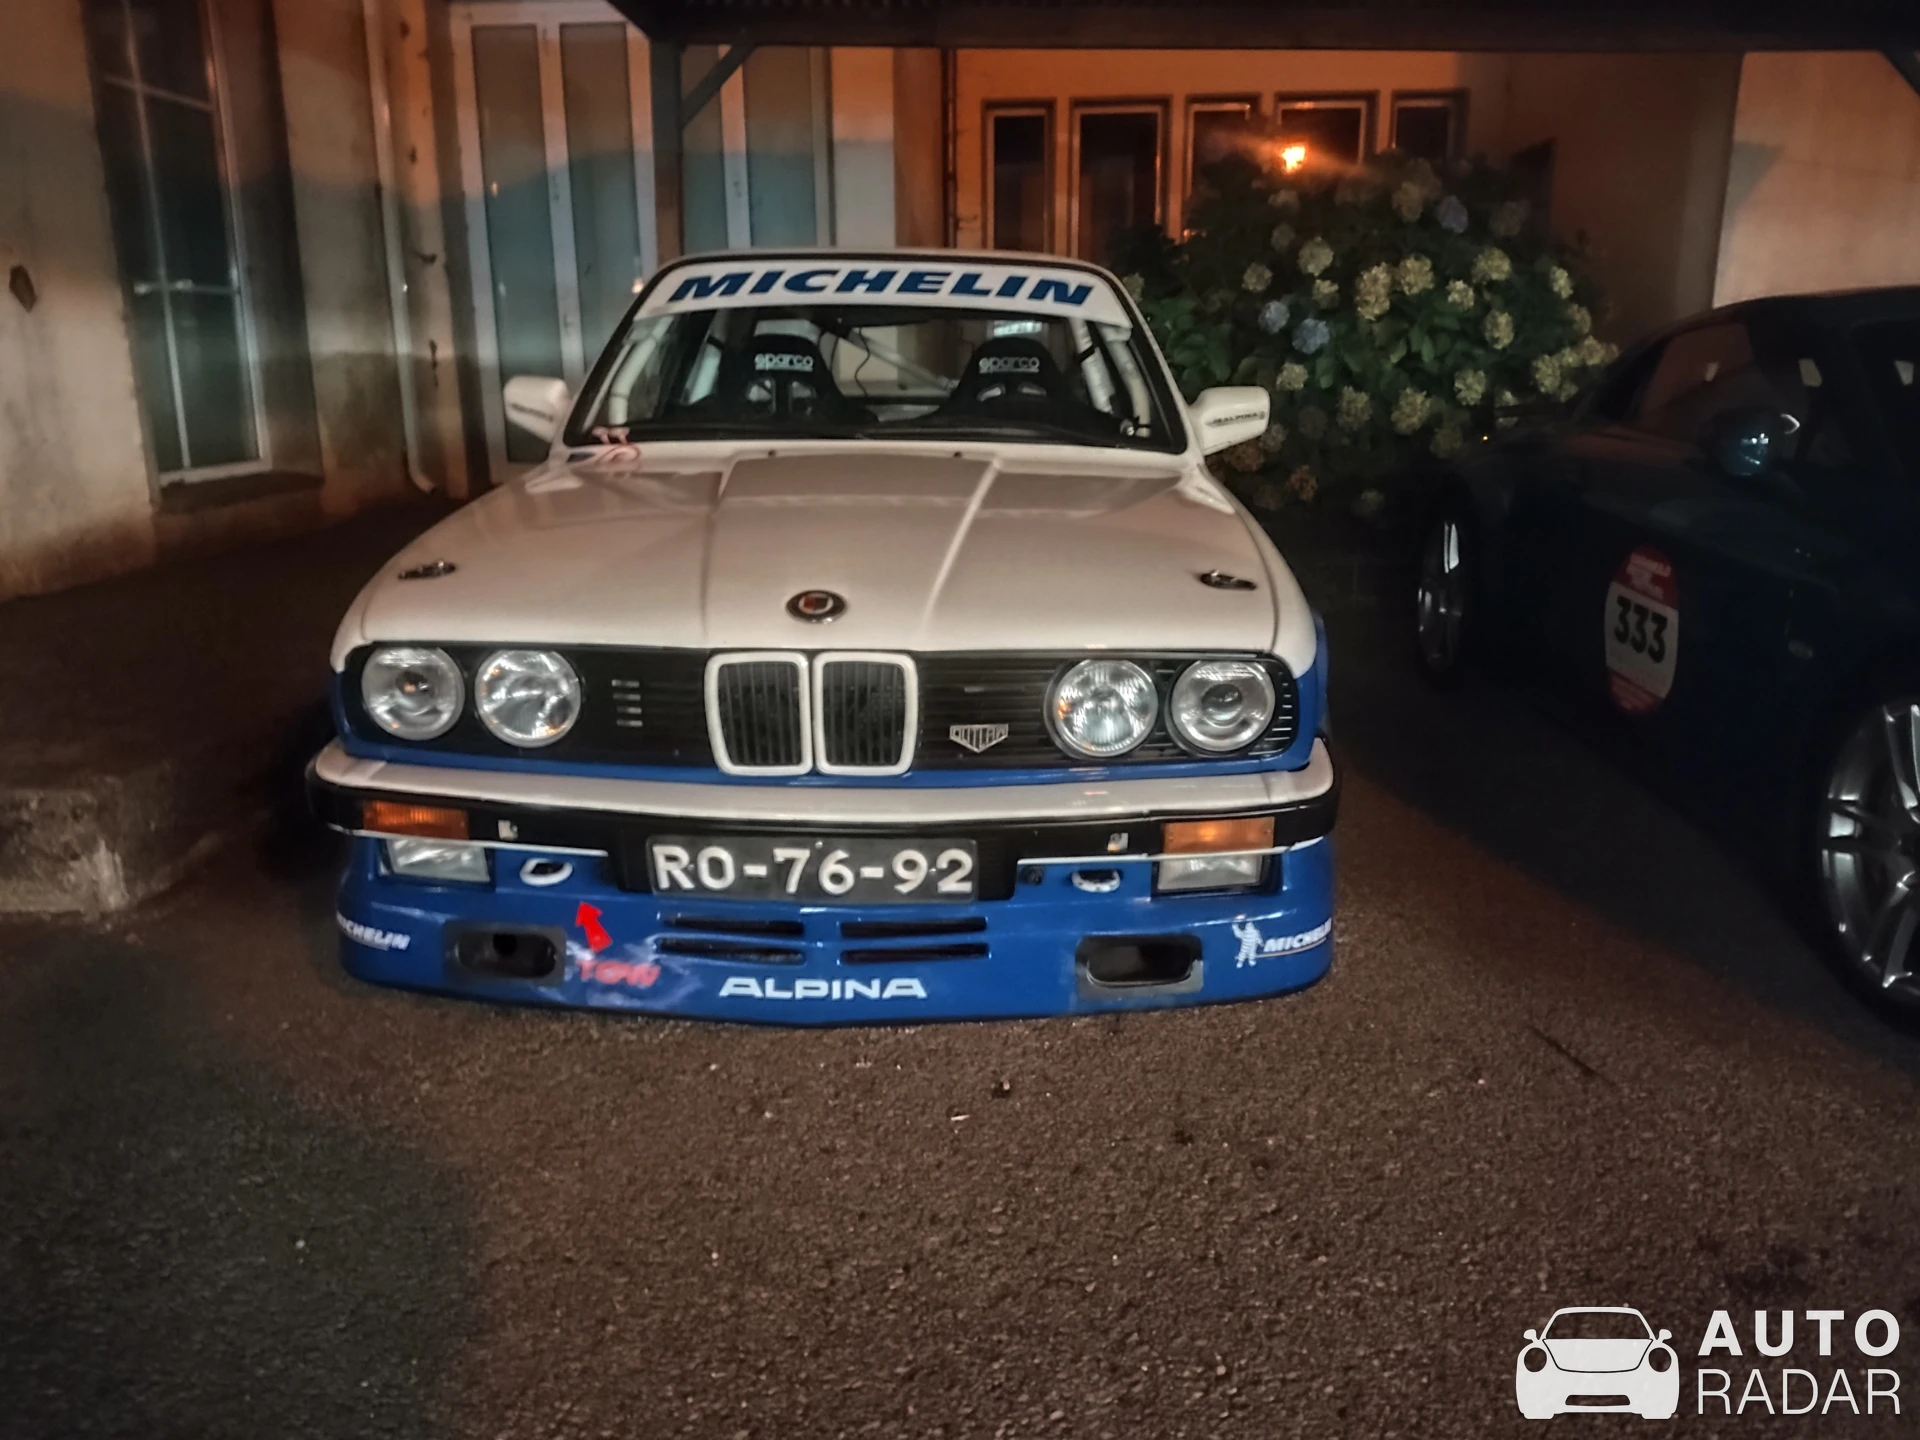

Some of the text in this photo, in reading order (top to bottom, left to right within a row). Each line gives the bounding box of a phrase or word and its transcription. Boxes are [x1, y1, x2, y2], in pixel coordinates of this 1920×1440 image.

[667, 269, 1094, 305] MICHELIN
[755, 353, 813, 371] sparco
[979, 357, 1039, 372] sparco
[1614, 595, 1667, 663] 333
[652, 844, 974, 895] RO-76-92
[336, 911, 411, 951] ICHELIN
[719, 977, 928, 1000] ALPINA
